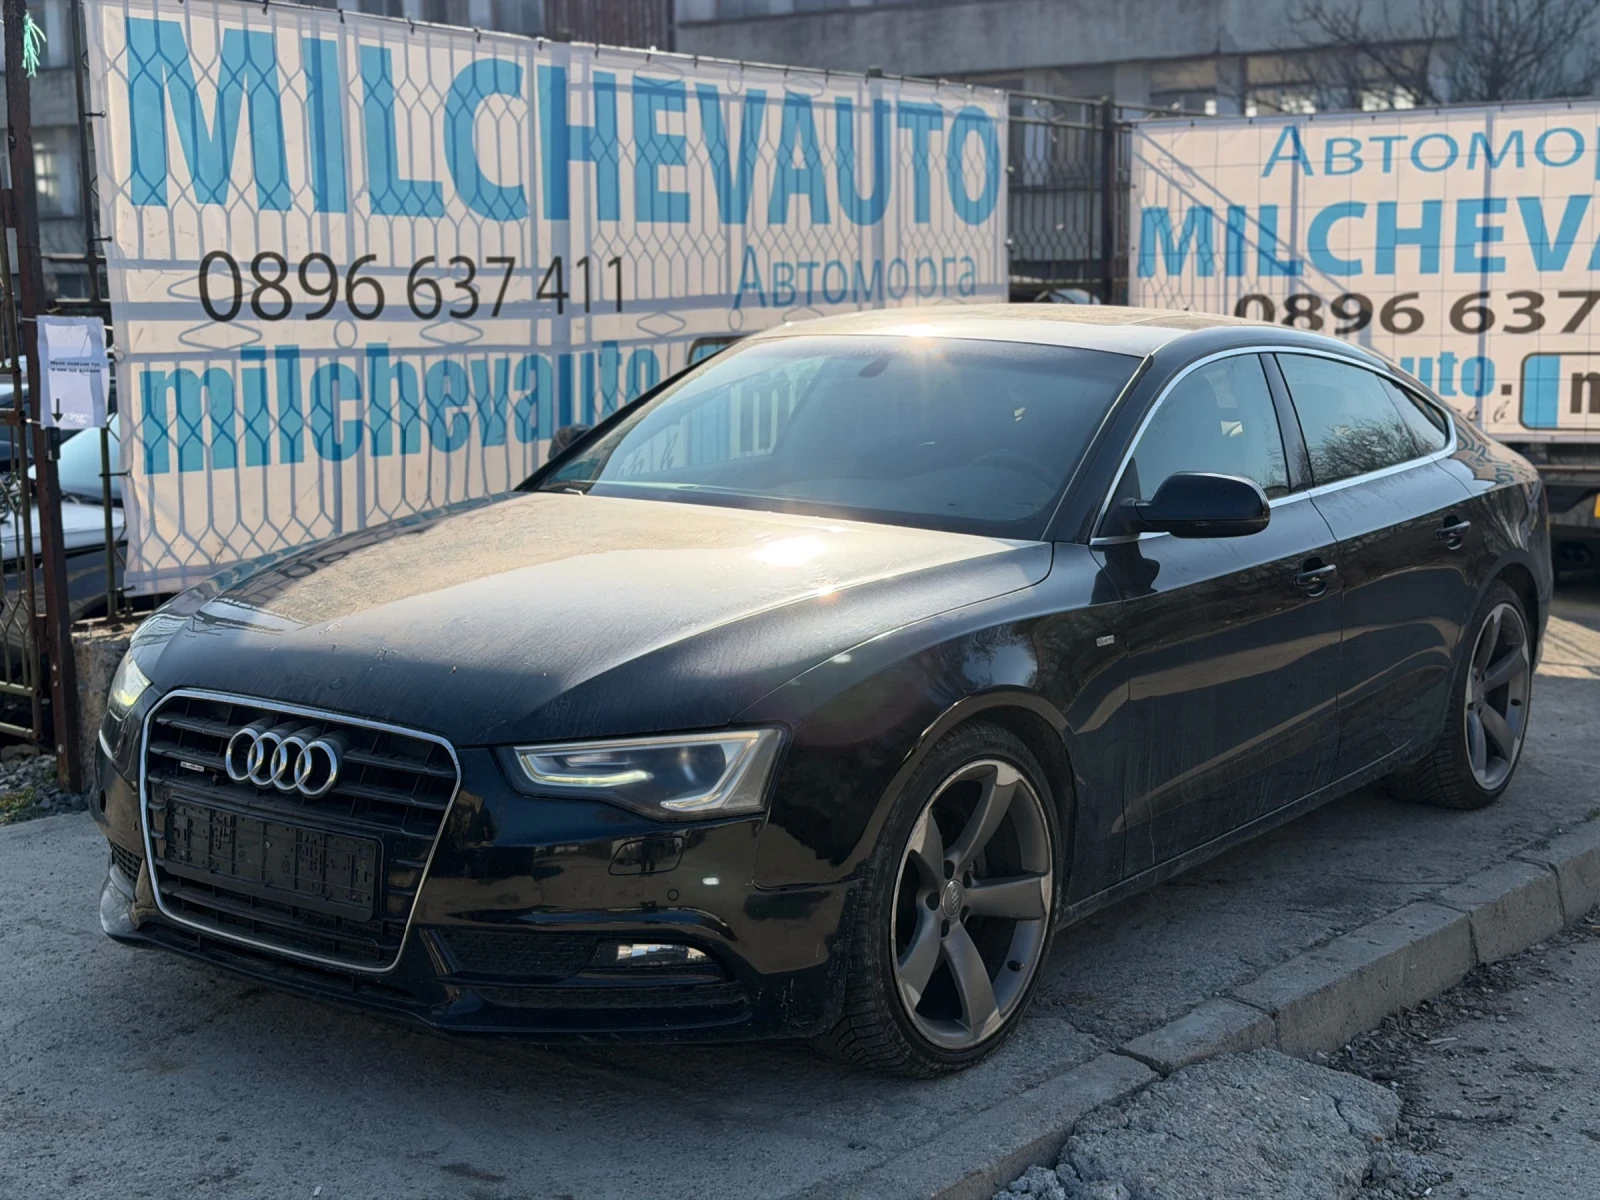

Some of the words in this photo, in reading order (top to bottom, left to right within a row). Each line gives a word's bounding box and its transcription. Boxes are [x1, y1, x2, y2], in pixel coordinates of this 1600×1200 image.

[125, 16, 1000, 227] MILCHEVAUTO
[1261, 125, 1600, 181] Автомо
[1137, 194, 1600, 278] MILCHEV
[198, 250, 385, 322] 0896
[406, 255, 516, 320] 637
[536, 255, 623, 315] 411
[733, 244, 977, 310] Автоморга
[1234, 291, 1425, 335] 0896
[1449, 290, 1600, 335] 637
[140, 341, 660, 475] milchevauto
